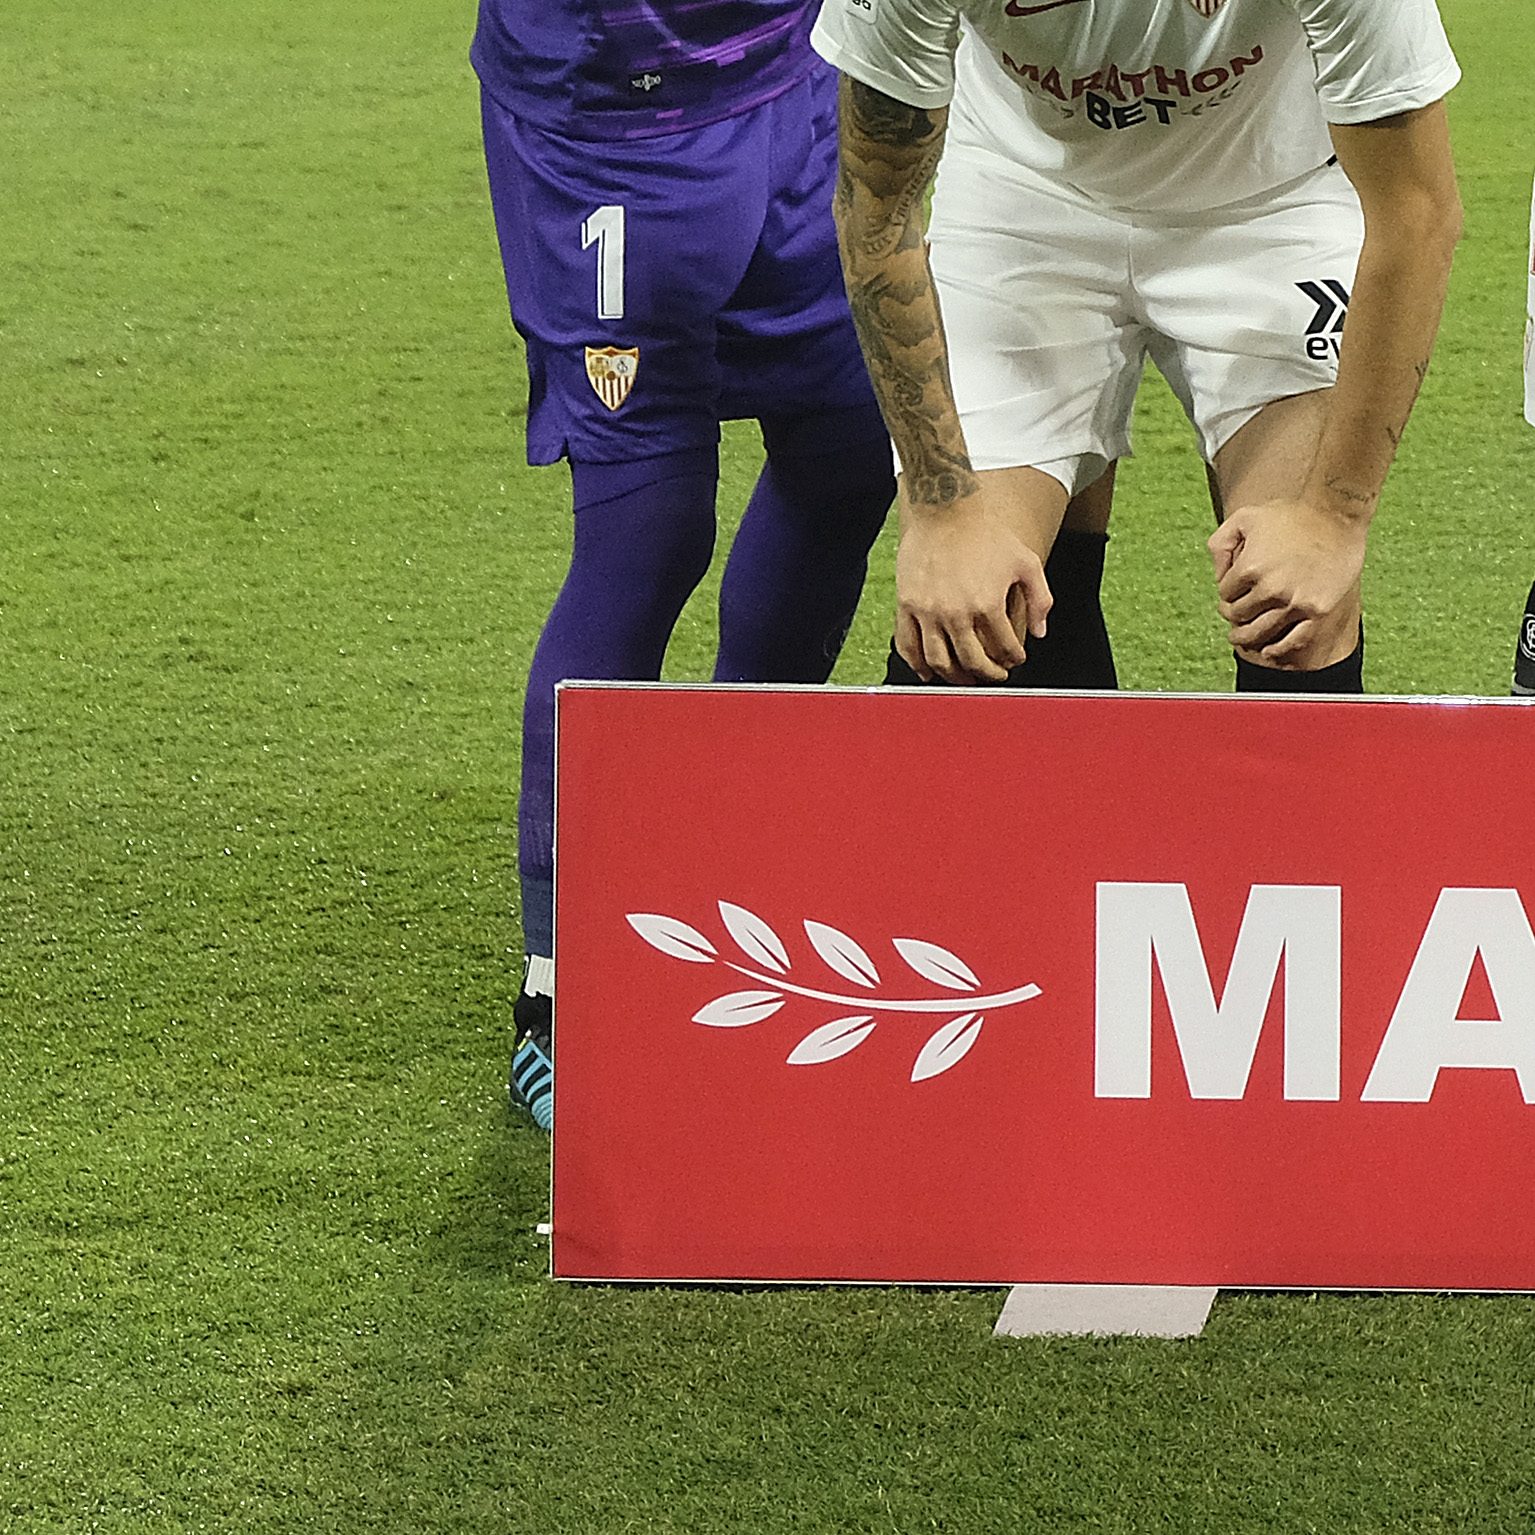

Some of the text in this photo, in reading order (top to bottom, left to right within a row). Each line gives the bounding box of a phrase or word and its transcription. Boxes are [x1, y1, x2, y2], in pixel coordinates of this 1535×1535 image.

[1001, 44, 1264, 102] MARATHON
[1085, 91, 1178, 130] BET
[580, 204, 626, 320] 1
